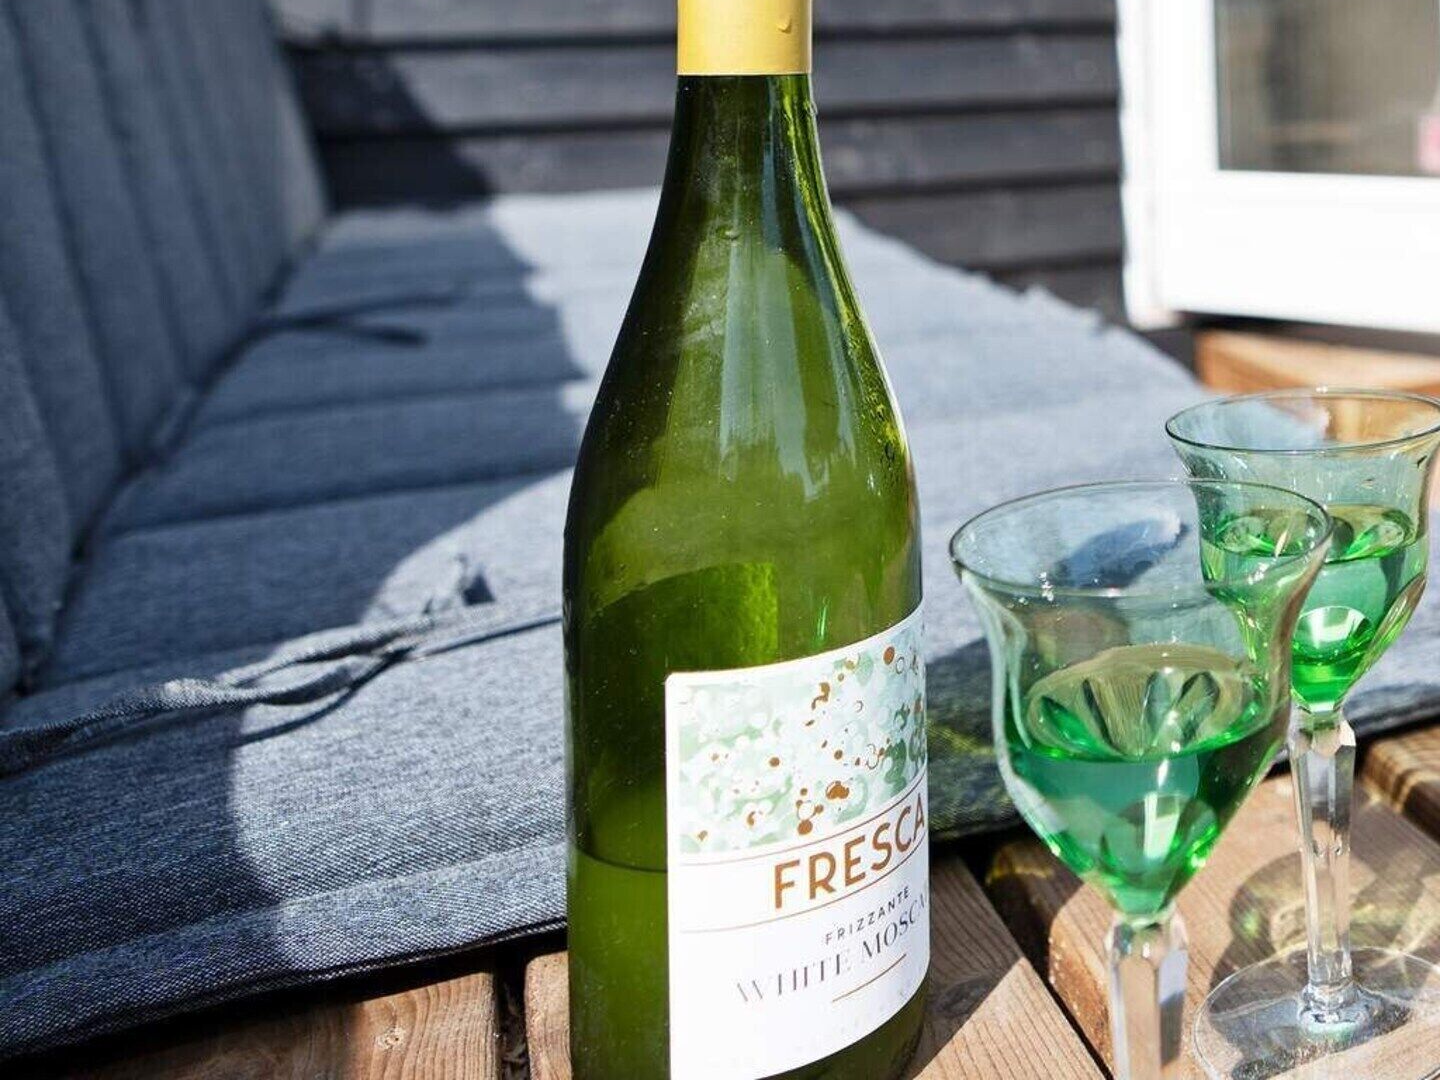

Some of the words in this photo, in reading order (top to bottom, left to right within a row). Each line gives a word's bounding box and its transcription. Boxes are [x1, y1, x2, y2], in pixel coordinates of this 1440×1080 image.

[773, 792, 926, 910] FRESCA
[736, 946, 852, 1003] WHITE
[860, 890, 927, 962] MOSCA
[824, 885, 911, 945] FRIZZANTE
